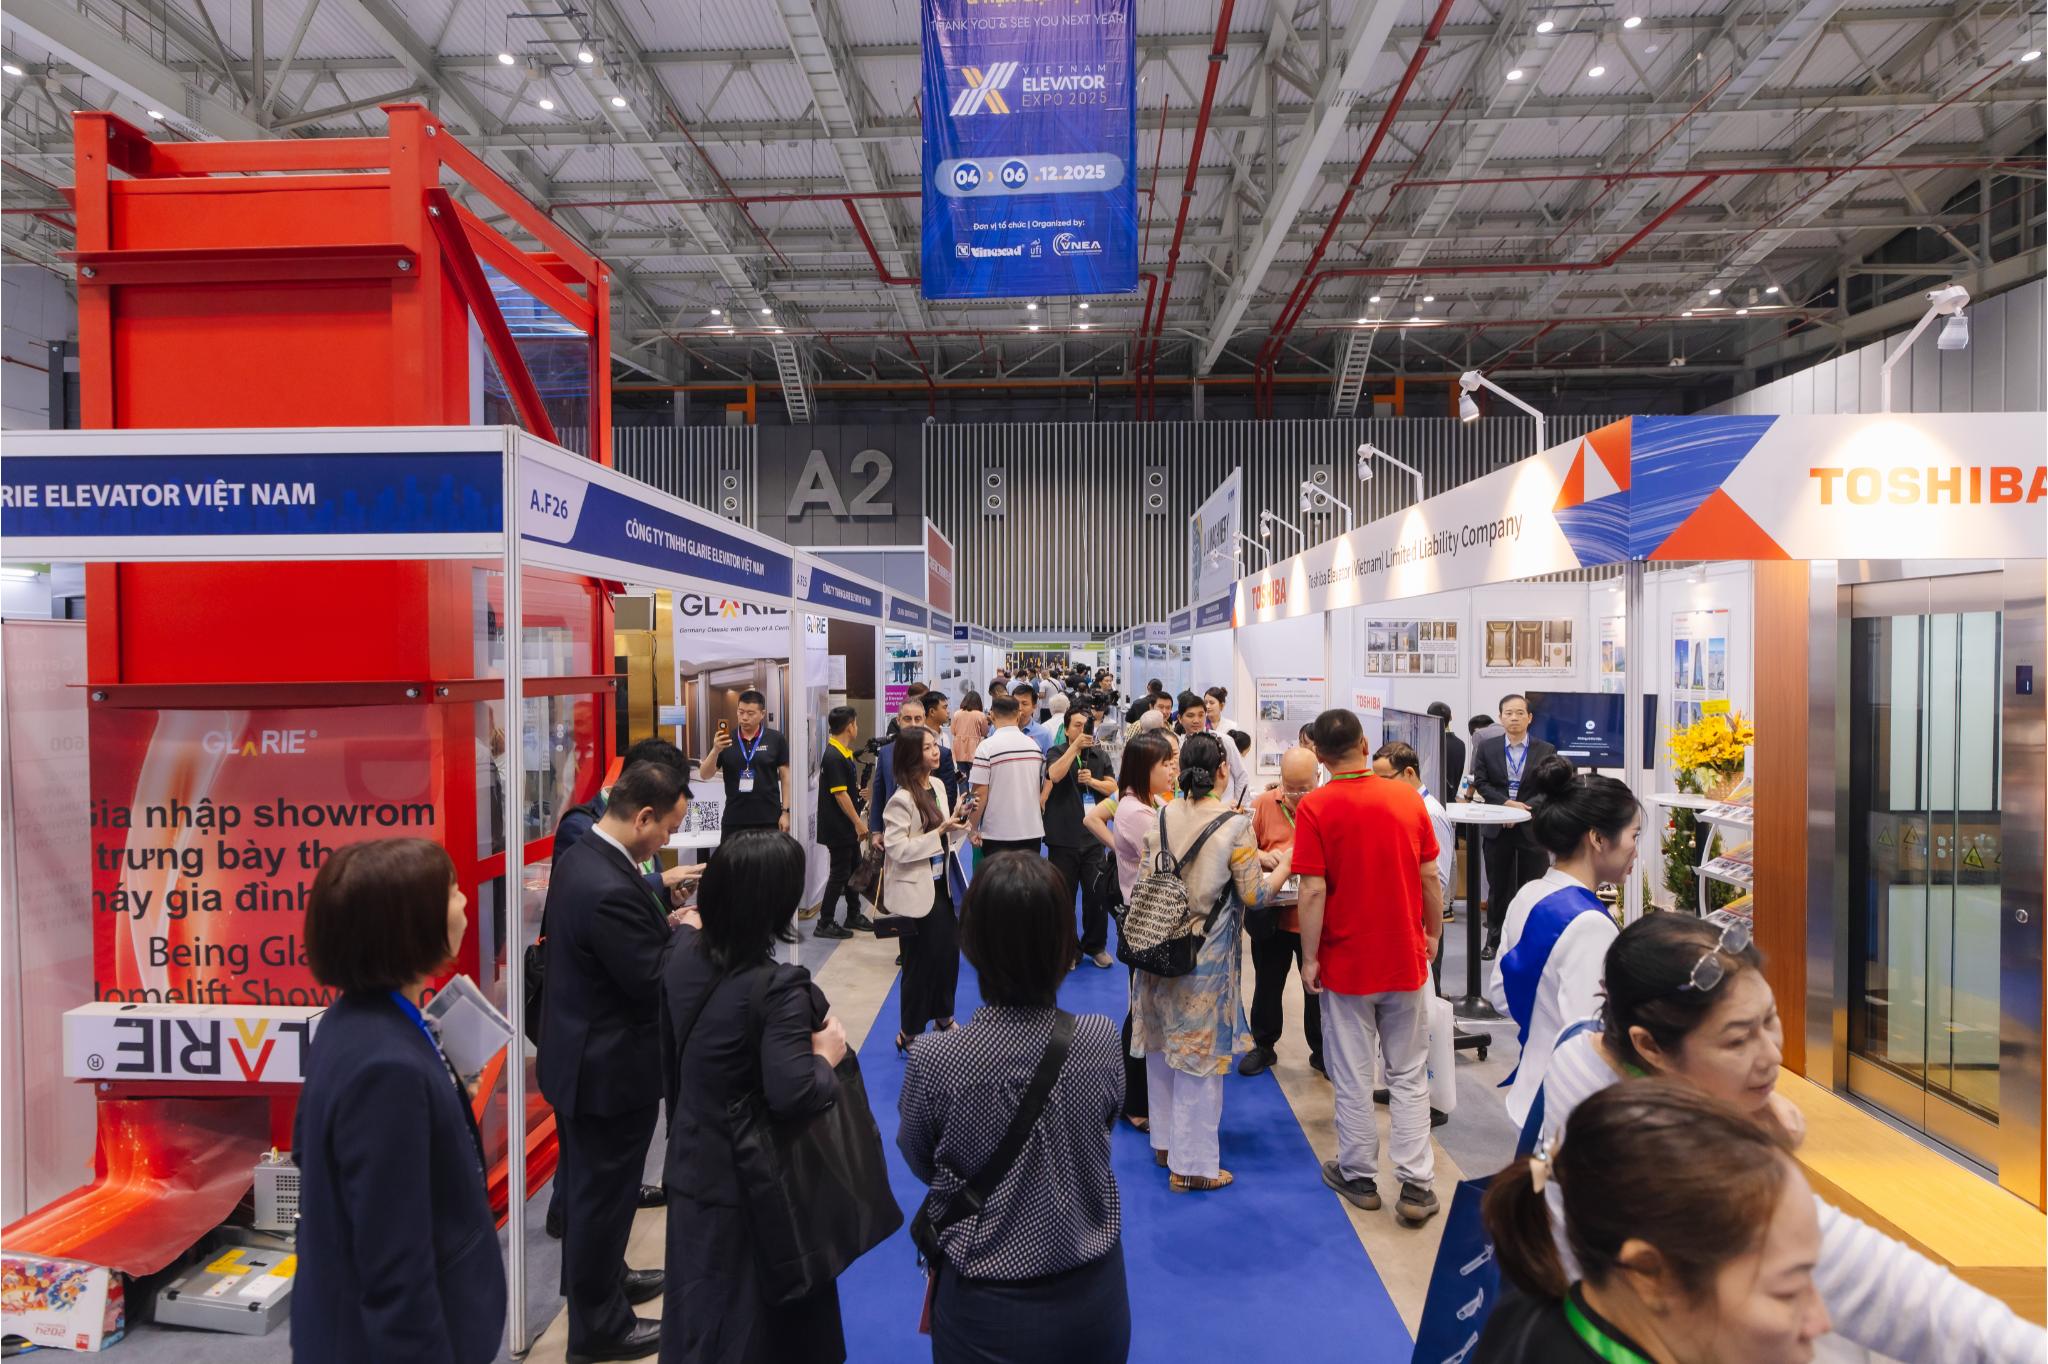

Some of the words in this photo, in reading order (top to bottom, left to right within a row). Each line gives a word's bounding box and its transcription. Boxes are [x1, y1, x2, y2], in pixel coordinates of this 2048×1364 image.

[931, 18, 968, 32] THANK
[970, 17, 998, 31] YOU
[1010, 16, 1031, 29] SEE
[1032, 15, 1060, 28] YOU
[1062, 14, 1092, 27] NEXT
[1022, 63, 1107, 76] VIETNAM
[1022, 75, 1106, 92] ELEVATOR
[1022, 92, 1064, 107] EXPO
[1069, 90, 1108, 106] 2025
[955, 168, 980, 186] 04
[1002, 166, 1027, 184] 06
[1031, 218, 1072, 231] Organized
[1061, 240, 1102, 250] VNEA
[44, 483, 181, 508] ELEVATOR
[185, 479, 245, 512] VIỆT
[250, 482, 316, 506] NAM
[786, 448, 894, 519] A2
[529, 487, 569, 520] A.F26
[625, 517, 653, 544] CÔNG
[652, 527, 665, 547] TY
[664, 531, 687, 553] TNHH
[687, 539, 712, 560] GLARIE
[712, 547, 741, 569] ELEVATOR
[1385, 544, 1417, 569] Limited
[1419, 531, 1460, 560] Liability
[1461, 513, 1523, 550] Company
[1251, 576, 1287, 612] TOSHIBA
[679, 626, 706, 635] Germany
[707, 625, 729, 633] Classic
[1356, 694, 1382, 711] TOSHIBA
[202, 729, 306, 757] GLARIE
[145, 797, 242, 835] nhập
[253, 797, 435, 828] showrom
[96, 842, 204, 878] trưng
[217, 839, 286, 877] bày
[297, 839, 335, 869] th
[166, 882, 223, 920] gia
[149, 936, 249, 975] Being
[260, 933, 309, 967] Gla
[94, 978, 231, 1004] omelift
